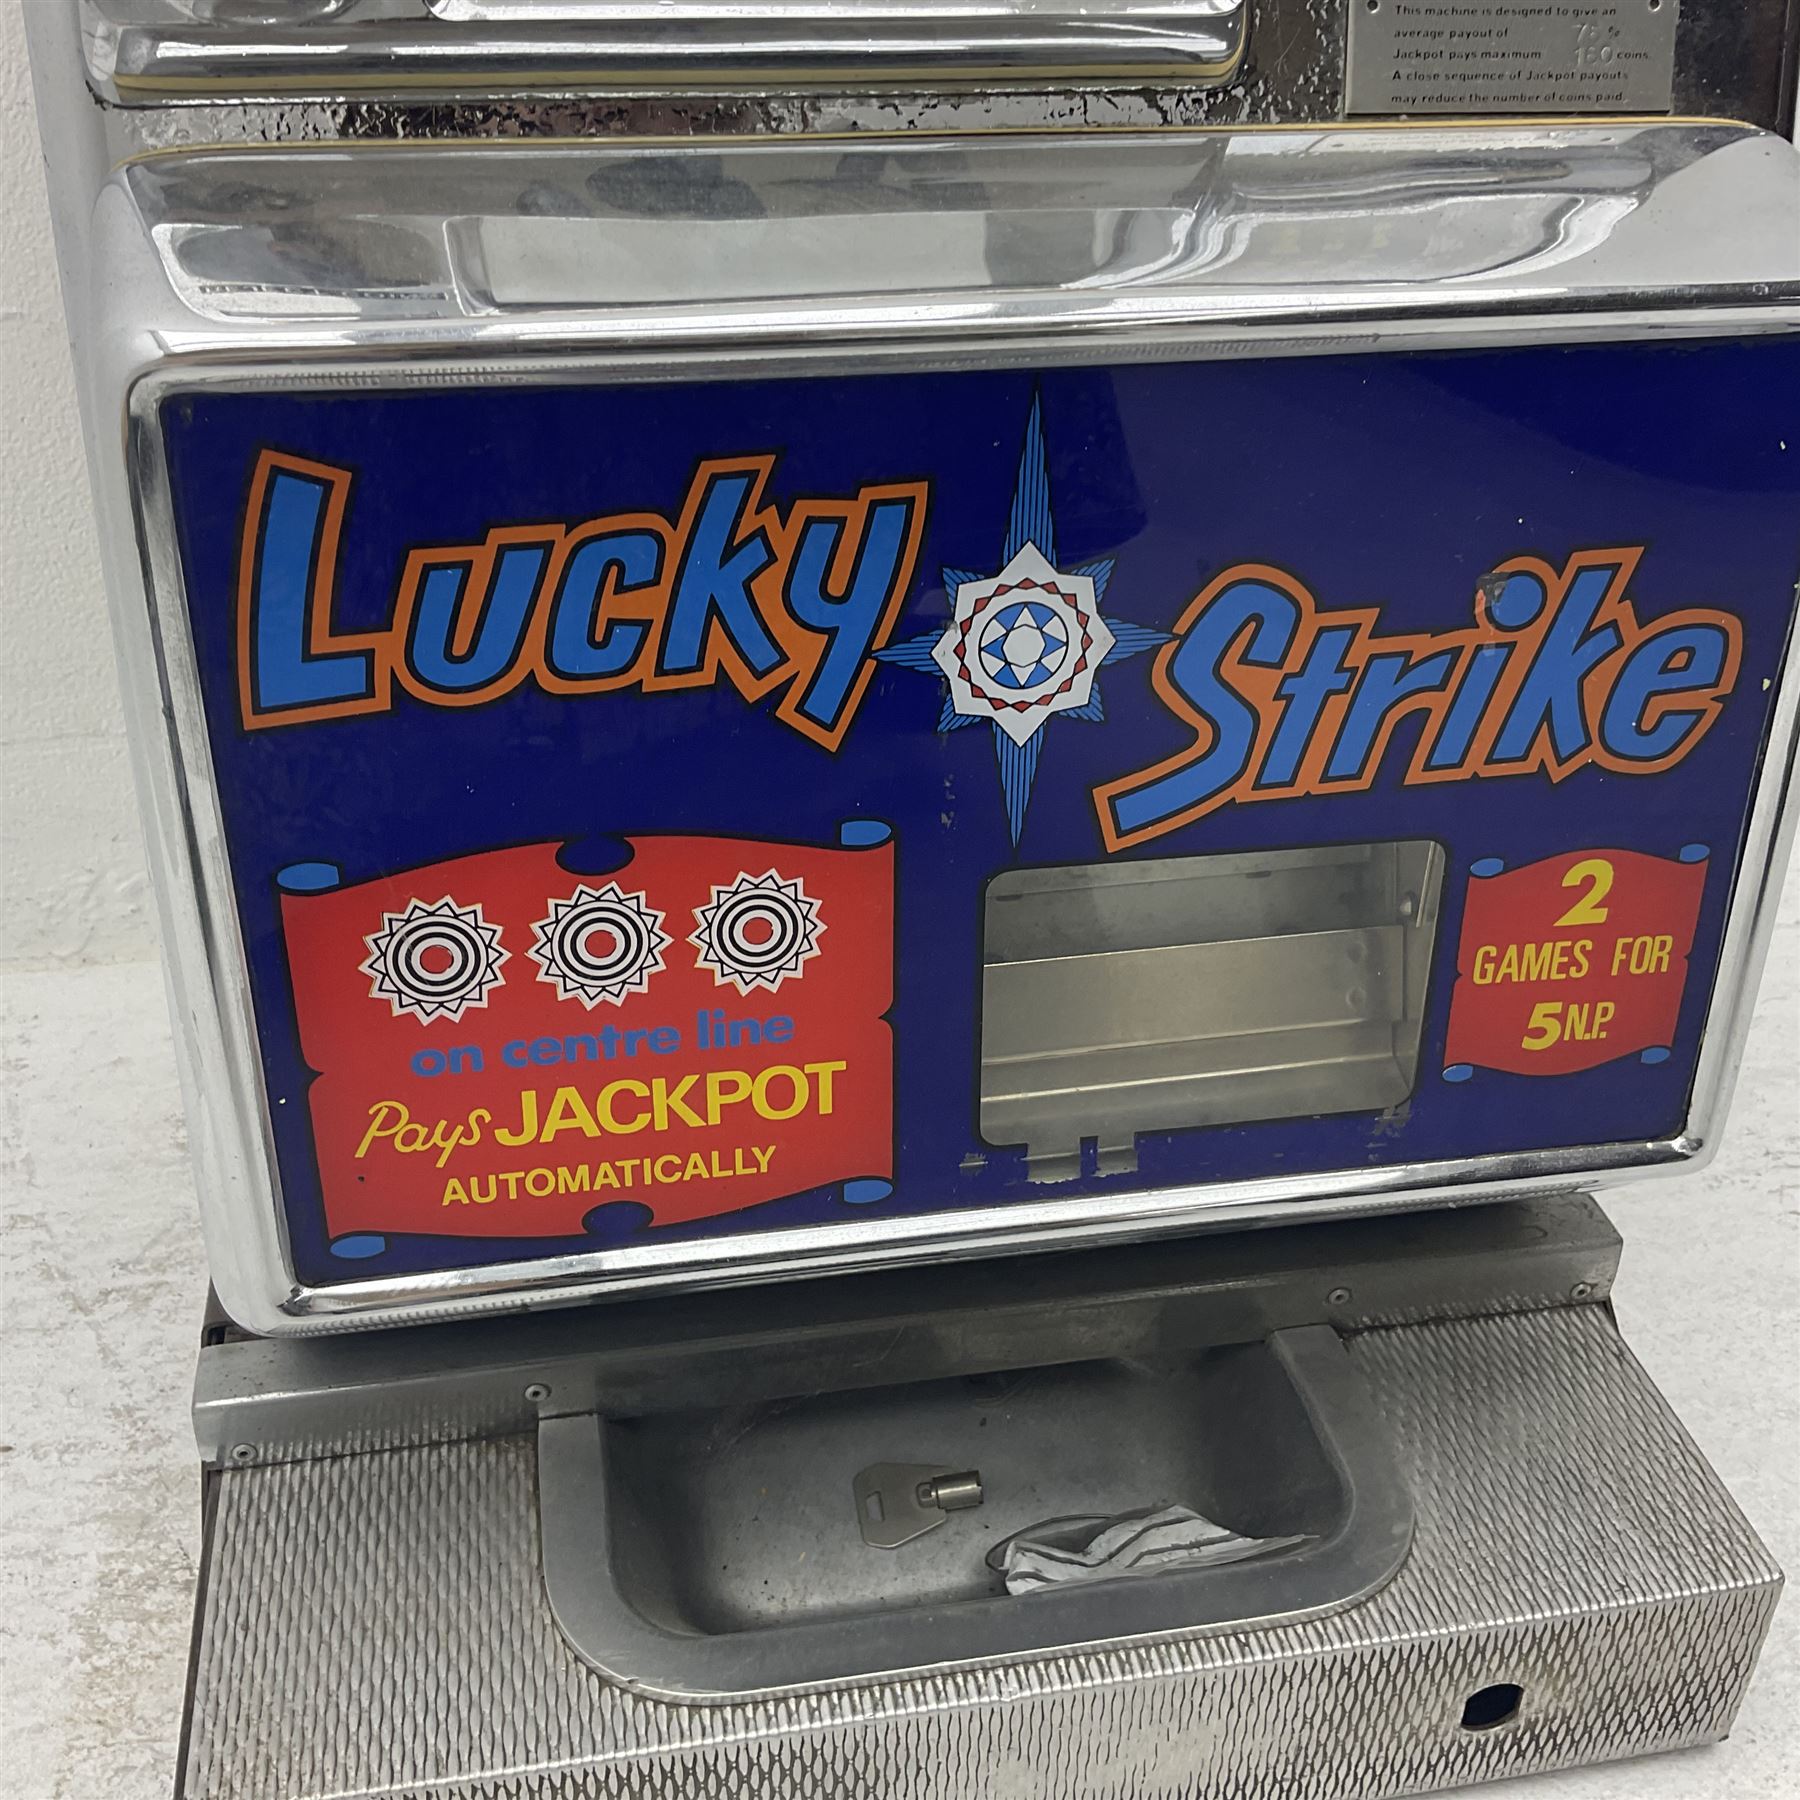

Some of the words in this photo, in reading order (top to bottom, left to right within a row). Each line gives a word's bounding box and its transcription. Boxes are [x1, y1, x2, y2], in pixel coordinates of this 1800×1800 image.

[1394, 30, 1444, 39] average
[1449, 28, 1492, 39] payout
[1496, 27, 1508, 38] of
[1395, 5, 1420, 15] This
[1425, 6, 1478, 16] machine
[1482, 8, 1492, 16] is
[1495, 6, 1552, 18] designed
[1556, 7, 1569, 16] to
[1572, 8, 1598, 18] give
[1602, 8, 1617, 16] an
[1392, 70, 1401, 80] A
[1406, 71, 1440, 80] close
[1444, 72, 1504, 82] sequence
[1509, 70, 1521, 80] of
[1527, 70, 1574, 81] Jackpot
[1580, 71, 1628, 81] payouts
[1393, 49, 1443, 60] Jackpot
[1449, 51, 1477, 60] pays
[1480, 51, 1541, 59] maximum
[1391, 95, 1416, 106] may
[1422, 94, 1465, 103] reduce
[1468, 93, 1489, 103] the
[1493, 93, 1540, 103] number
[1544, 92, 1556, 102] of
[1559, 94, 1592, 102] coins
[238, 449, 929, 752] Lucky
[1093, 547, 1743, 853] Strike
[1553, 858, 1615, 927] 2
[1472, 939, 1593, 985] GAMES
[1611, 935, 1673, 977] FOR
[411, 1044, 484, 1078] on
[503, 1023, 682, 1067] centre
[697, 1009, 795, 1049] line
[354, 1100, 491, 1168] Pays
[494, 1060, 847, 1147] JACKPOT
[441, 1145, 777, 1207] AUTOMATICALLY
